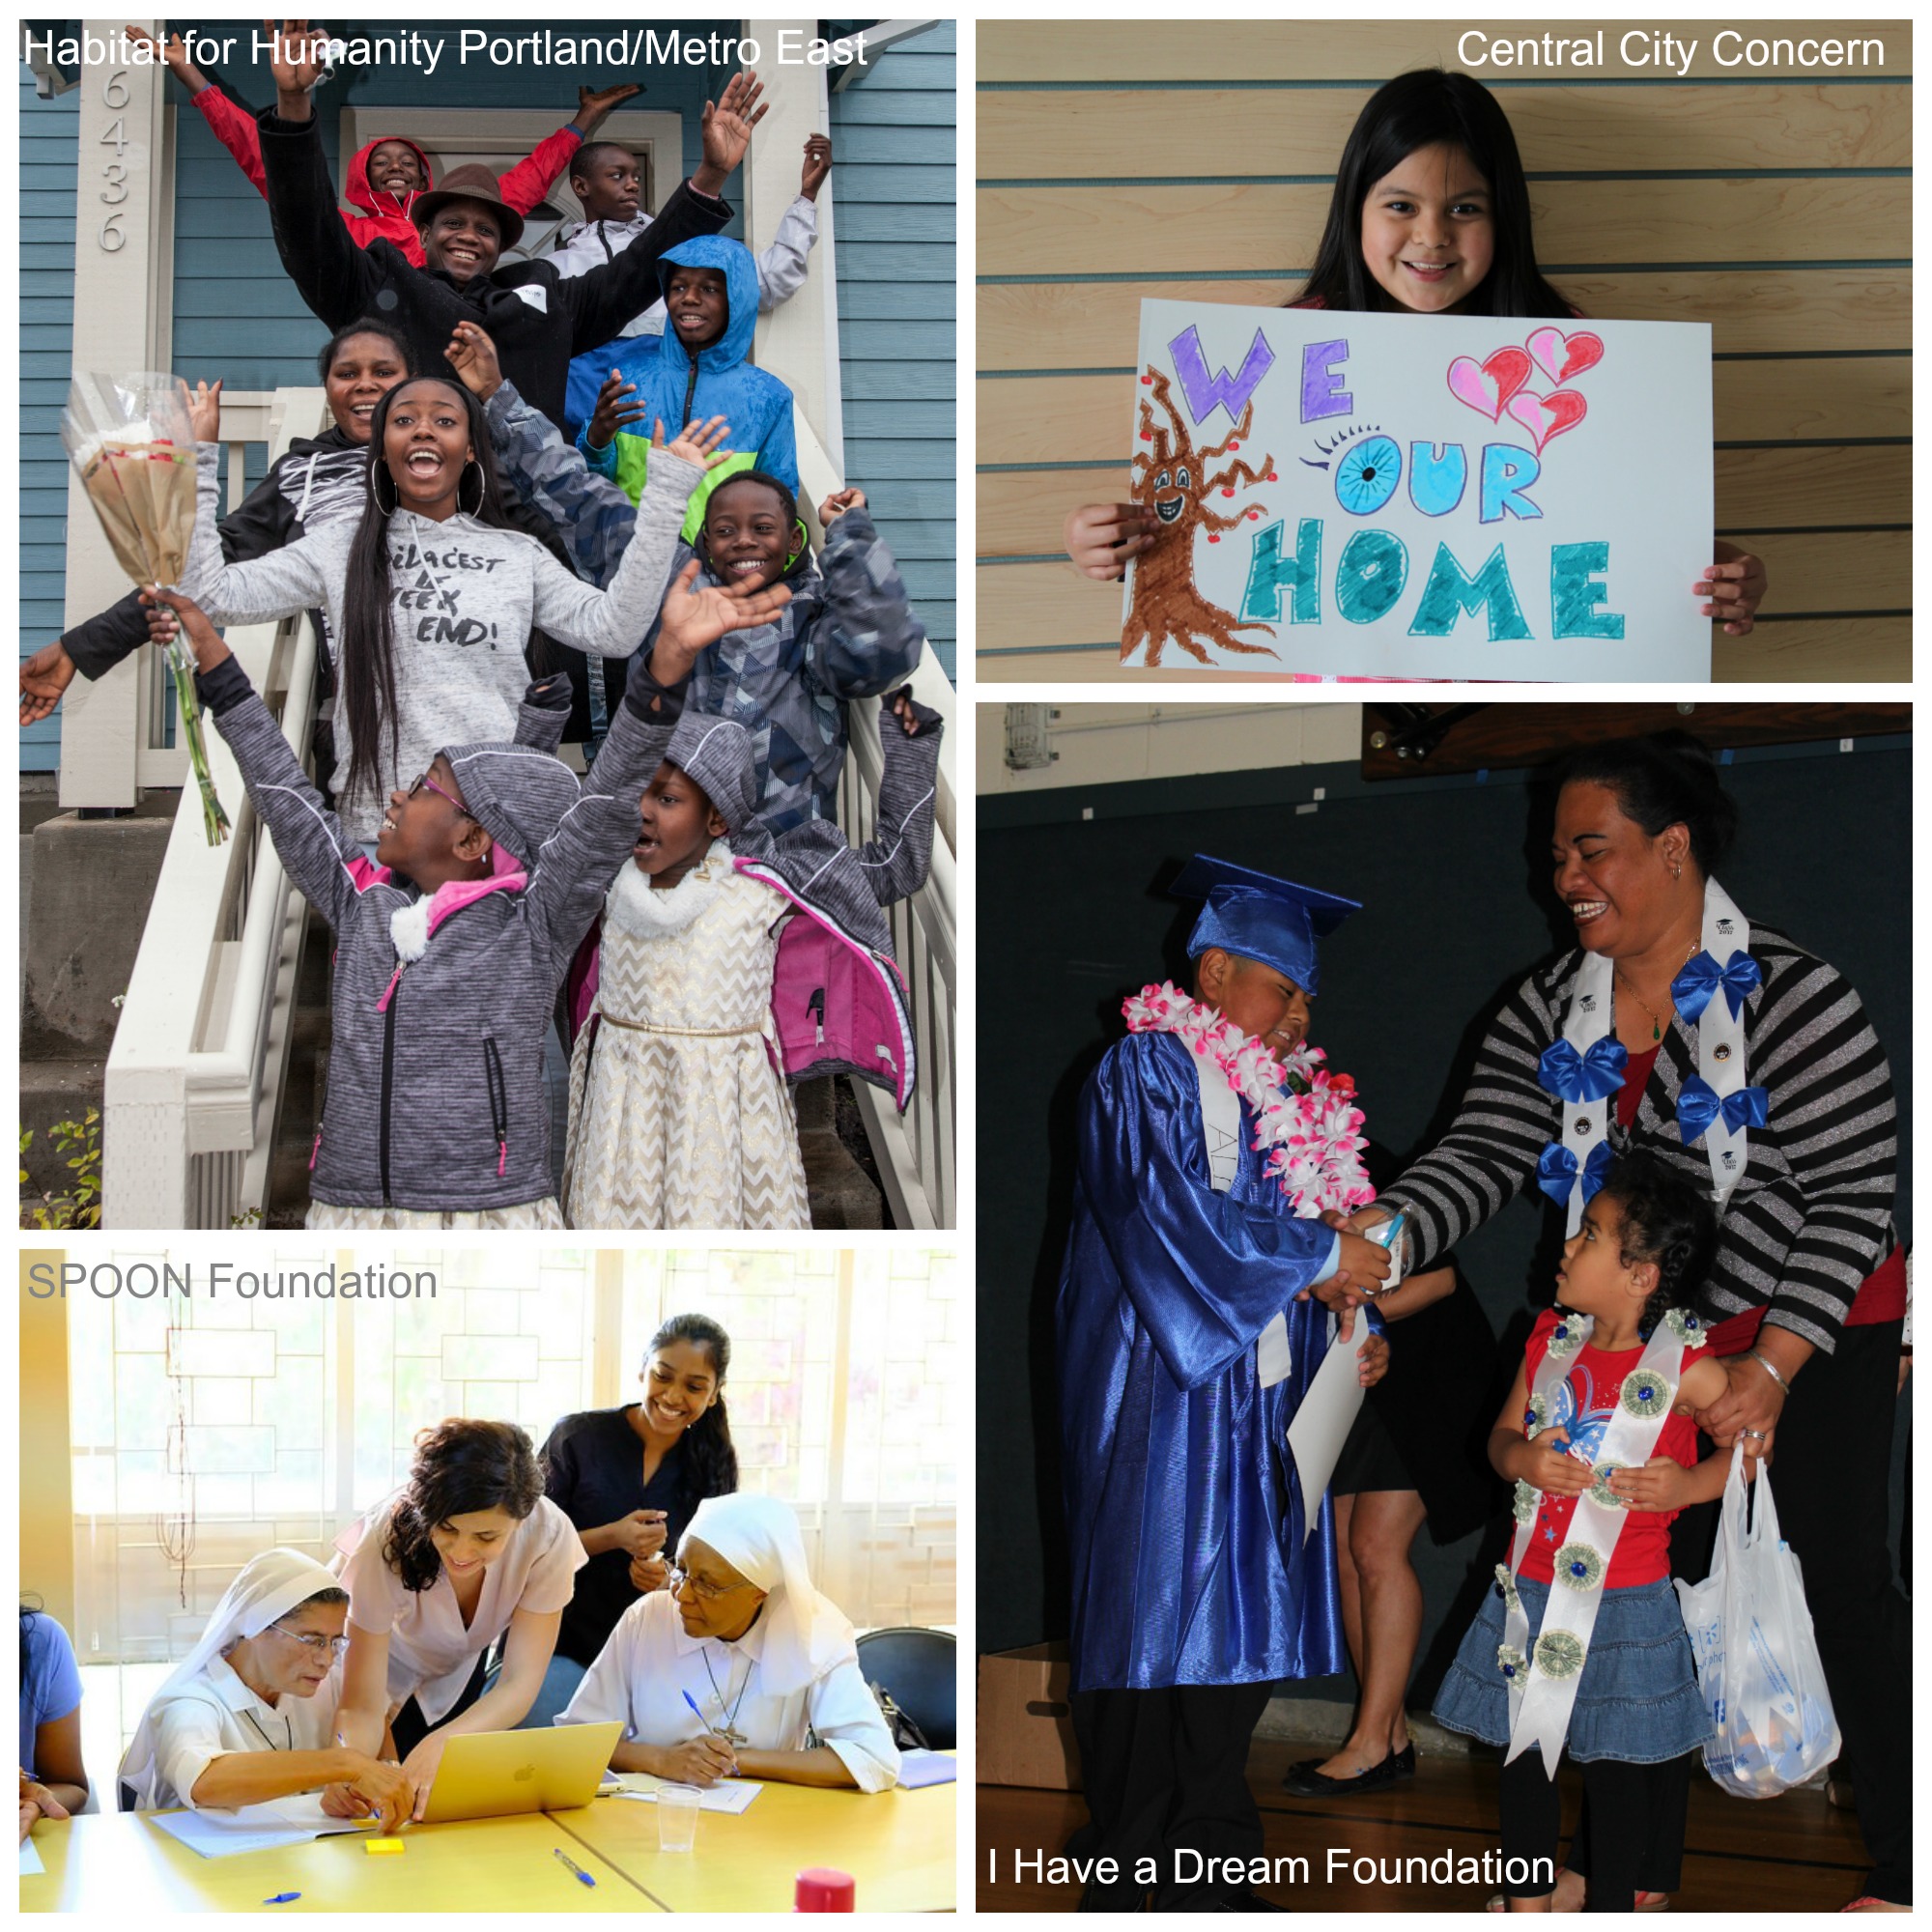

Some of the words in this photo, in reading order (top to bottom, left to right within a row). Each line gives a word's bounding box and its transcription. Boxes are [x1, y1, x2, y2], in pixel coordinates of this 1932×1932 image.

[1167, 324, 1353, 426] WE
[1335, 435, 1544, 524] OUR
[1238, 518, 1625, 641] HOME
[416, 616, 498, 651] END!
